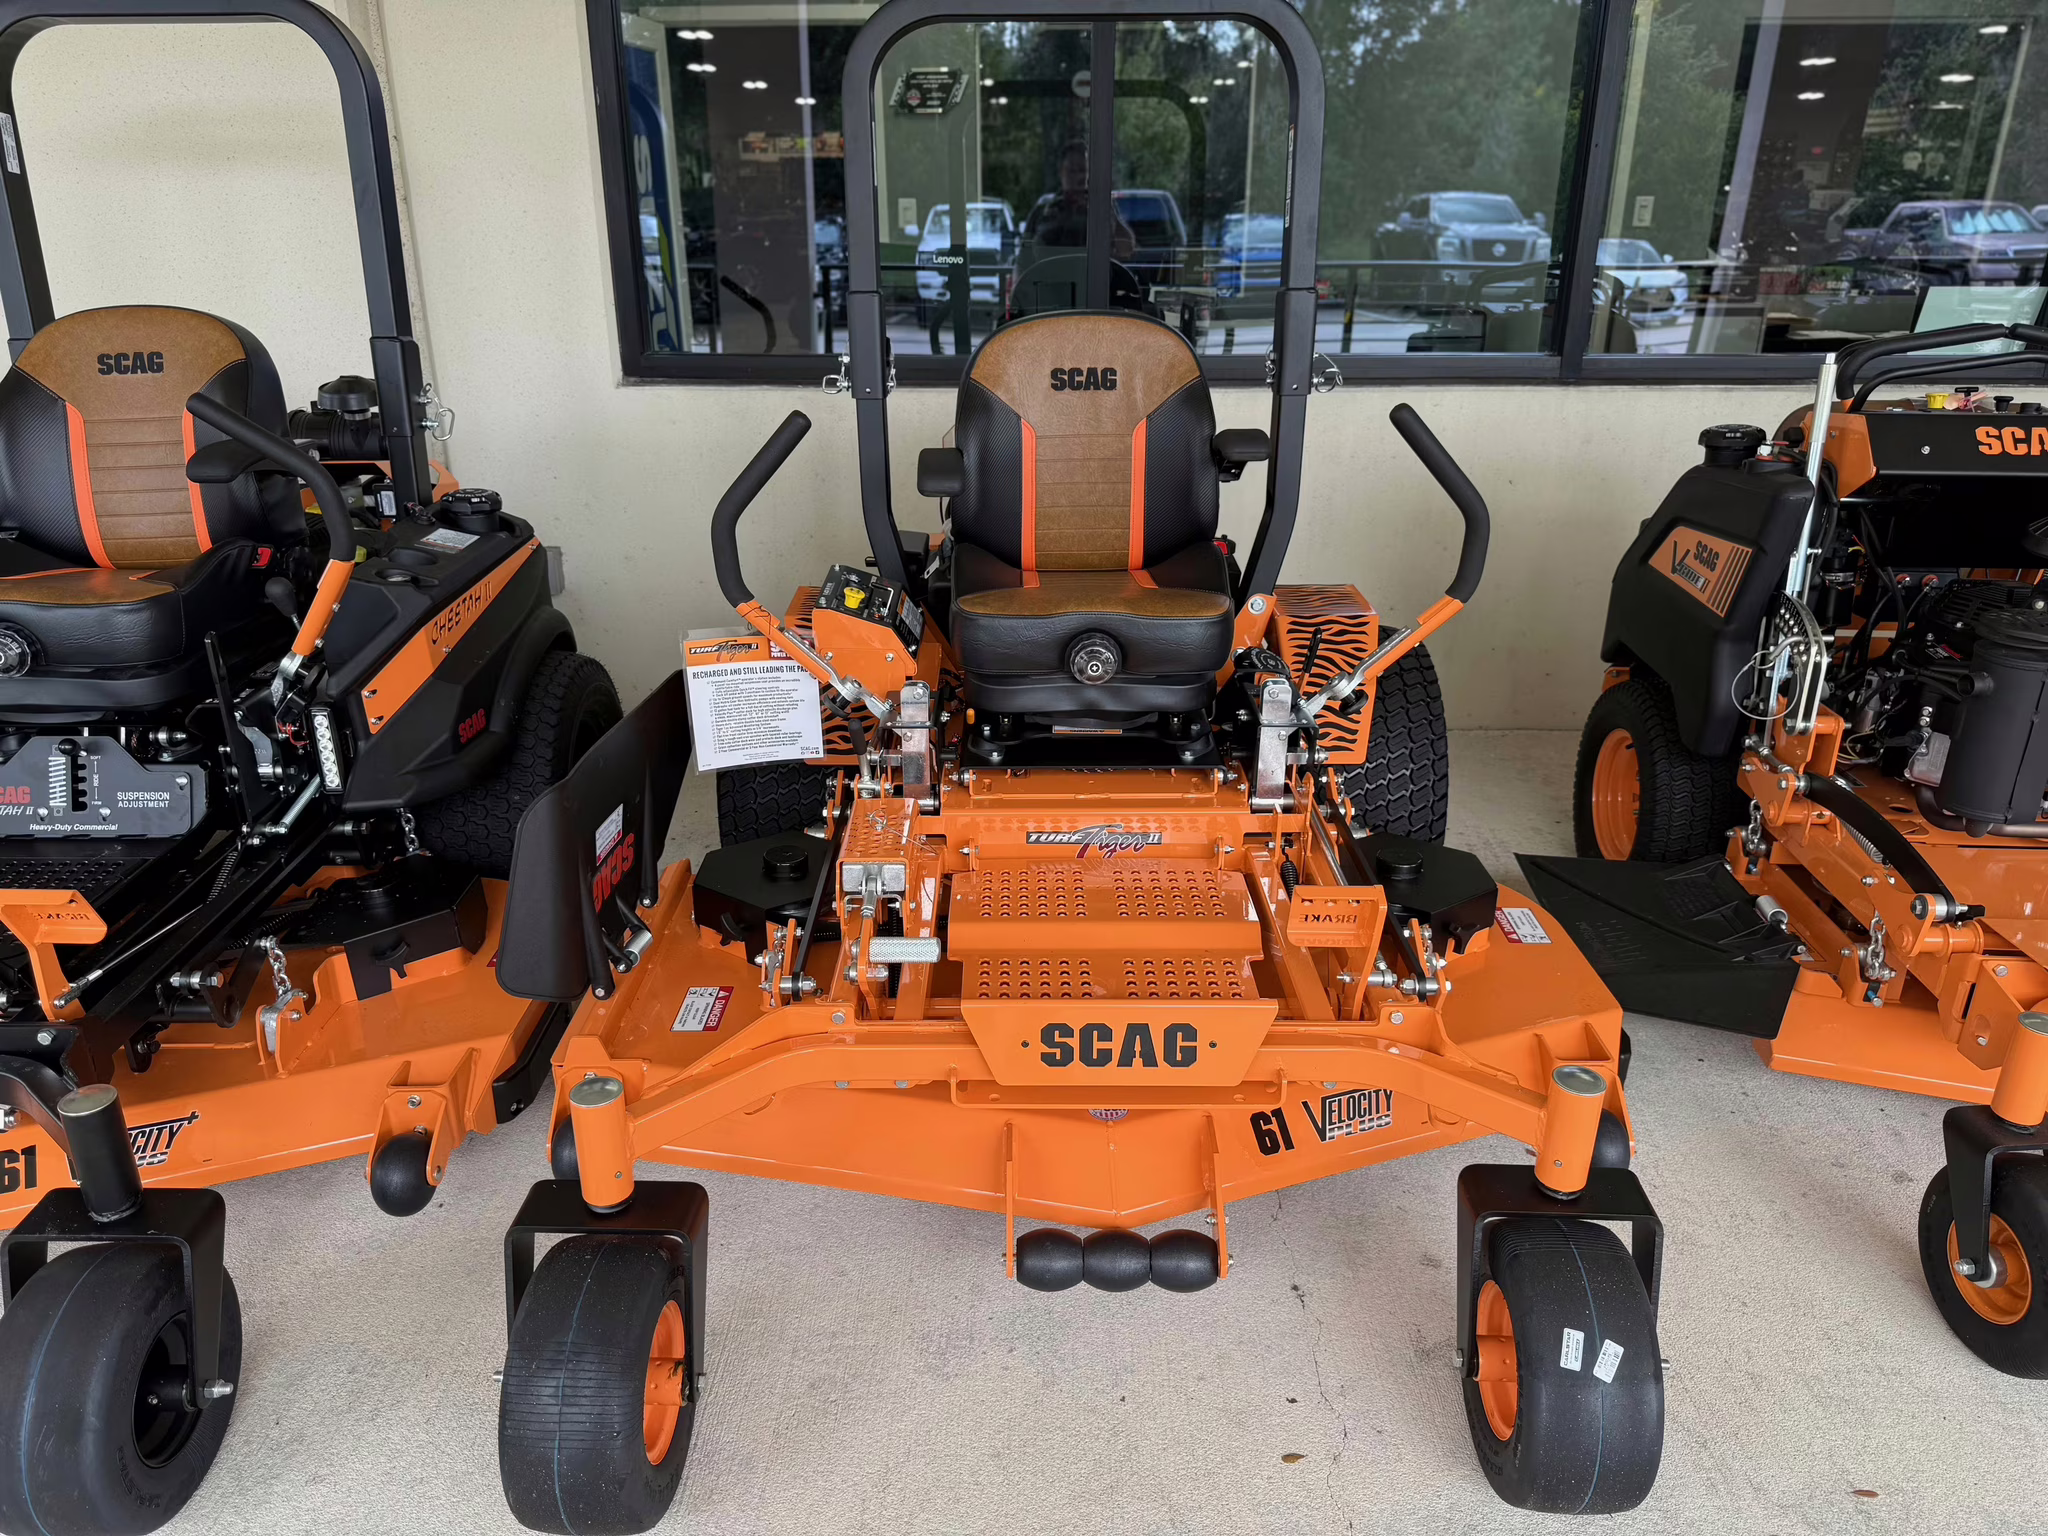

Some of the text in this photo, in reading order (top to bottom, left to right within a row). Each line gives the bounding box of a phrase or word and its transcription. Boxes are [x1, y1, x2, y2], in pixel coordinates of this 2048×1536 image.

[933, 255, 964, 264] Lenovo
[97, 351, 164, 376] SCAG
[1050, 367, 1118, 391] SCAG
[1975, 426, 2048, 455] SCA
[1693, 540, 1720, 572] SCAG
[432, 583, 484, 645] CHEETAH
[690, 645, 720, 654] TURF
[692, 669, 729, 679] RECHARGED
[730, 668, 742, 676] AND
[743, 667, 759, 675] STILL
[760, 665, 785, 674] LEADING
[0, 786, 32, 804] AG
[117, 792, 170, 800] SUSPENSION
[26, 806, 34, 815] II
[73, 823, 118, 831] Commercial
[1027, 824, 1161, 859] TURF Tiger II
[593, 833, 635, 913] SCAG
[706, 1000, 726, 1027] DANGER
[1041, 1023, 1197, 1067] SCAG
[1250, 1089, 1393, 1156] 61 VELOCITY
[1328, 1114, 1392, 1140] PLUS
[0, 1145, 37, 1194] 61
[1563, 1331, 1572, 1367] CARLSTAR
